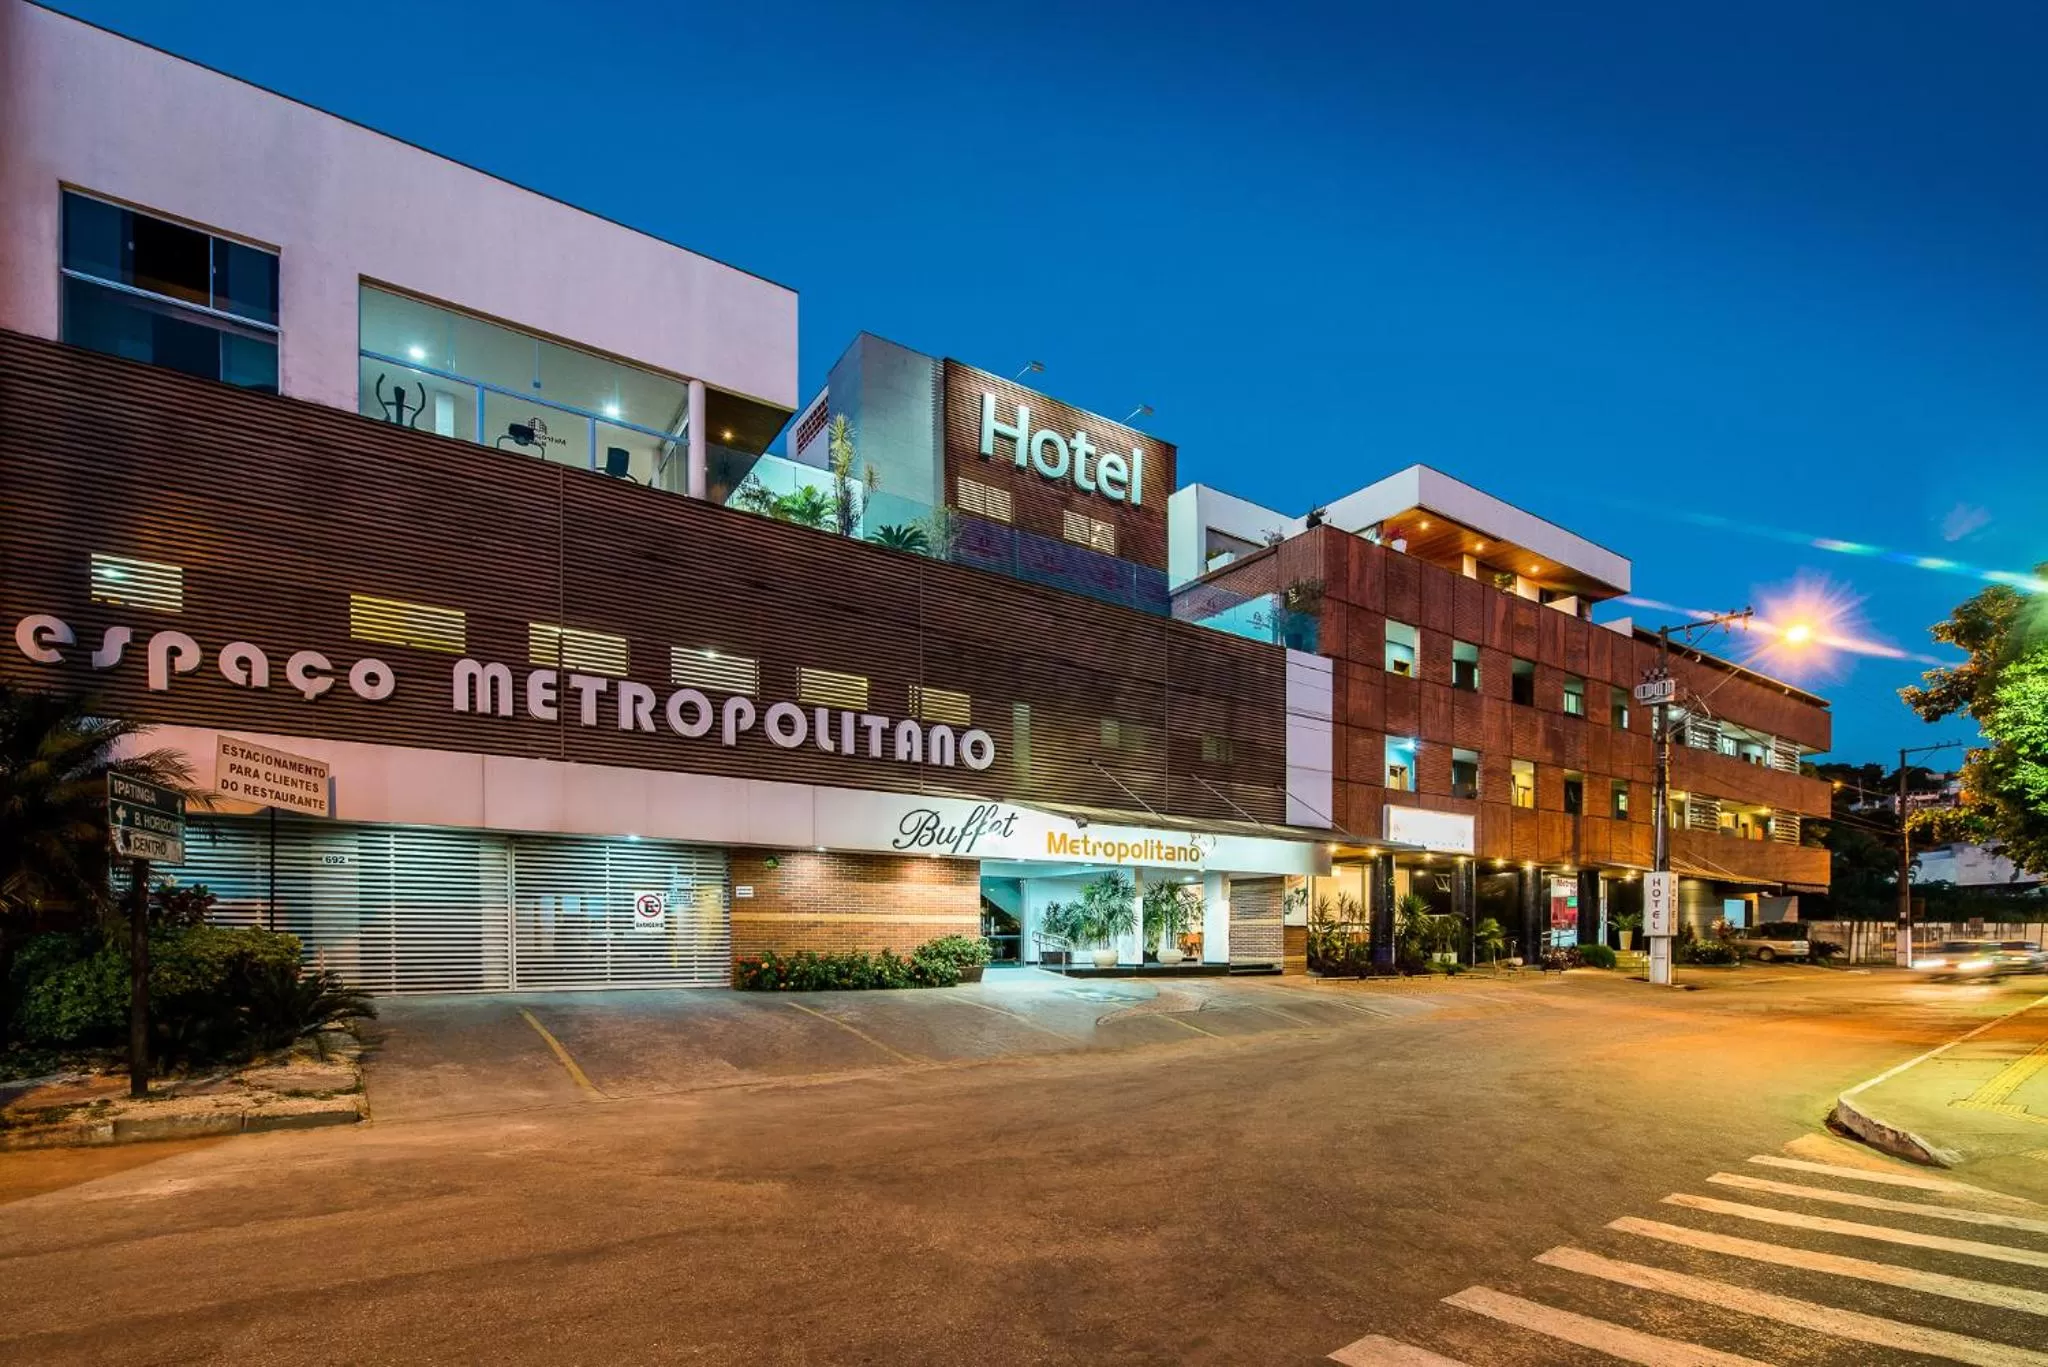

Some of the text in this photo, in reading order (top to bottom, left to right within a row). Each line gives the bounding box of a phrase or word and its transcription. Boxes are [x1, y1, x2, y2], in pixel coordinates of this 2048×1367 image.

[979, 391, 1142, 506] Hotel
[15, 614, 995, 770] espaço METROPOLITANO
[222, 744, 326, 778] ESTACIONAMENTO
[114, 780, 156, 805] IPATINGA
[229, 763, 319, 793] PARA CLIENTES
[221, 779, 325, 810] DO RESTAURANTE
[892, 803, 1018, 853] Buffet
[133, 837, 167, 855] CENTRO
[325, 855, 345, 864] 692
[1047, 831, 1200, 863] Metropolitano
[1652, 878, 1661, 929] HOTEL
